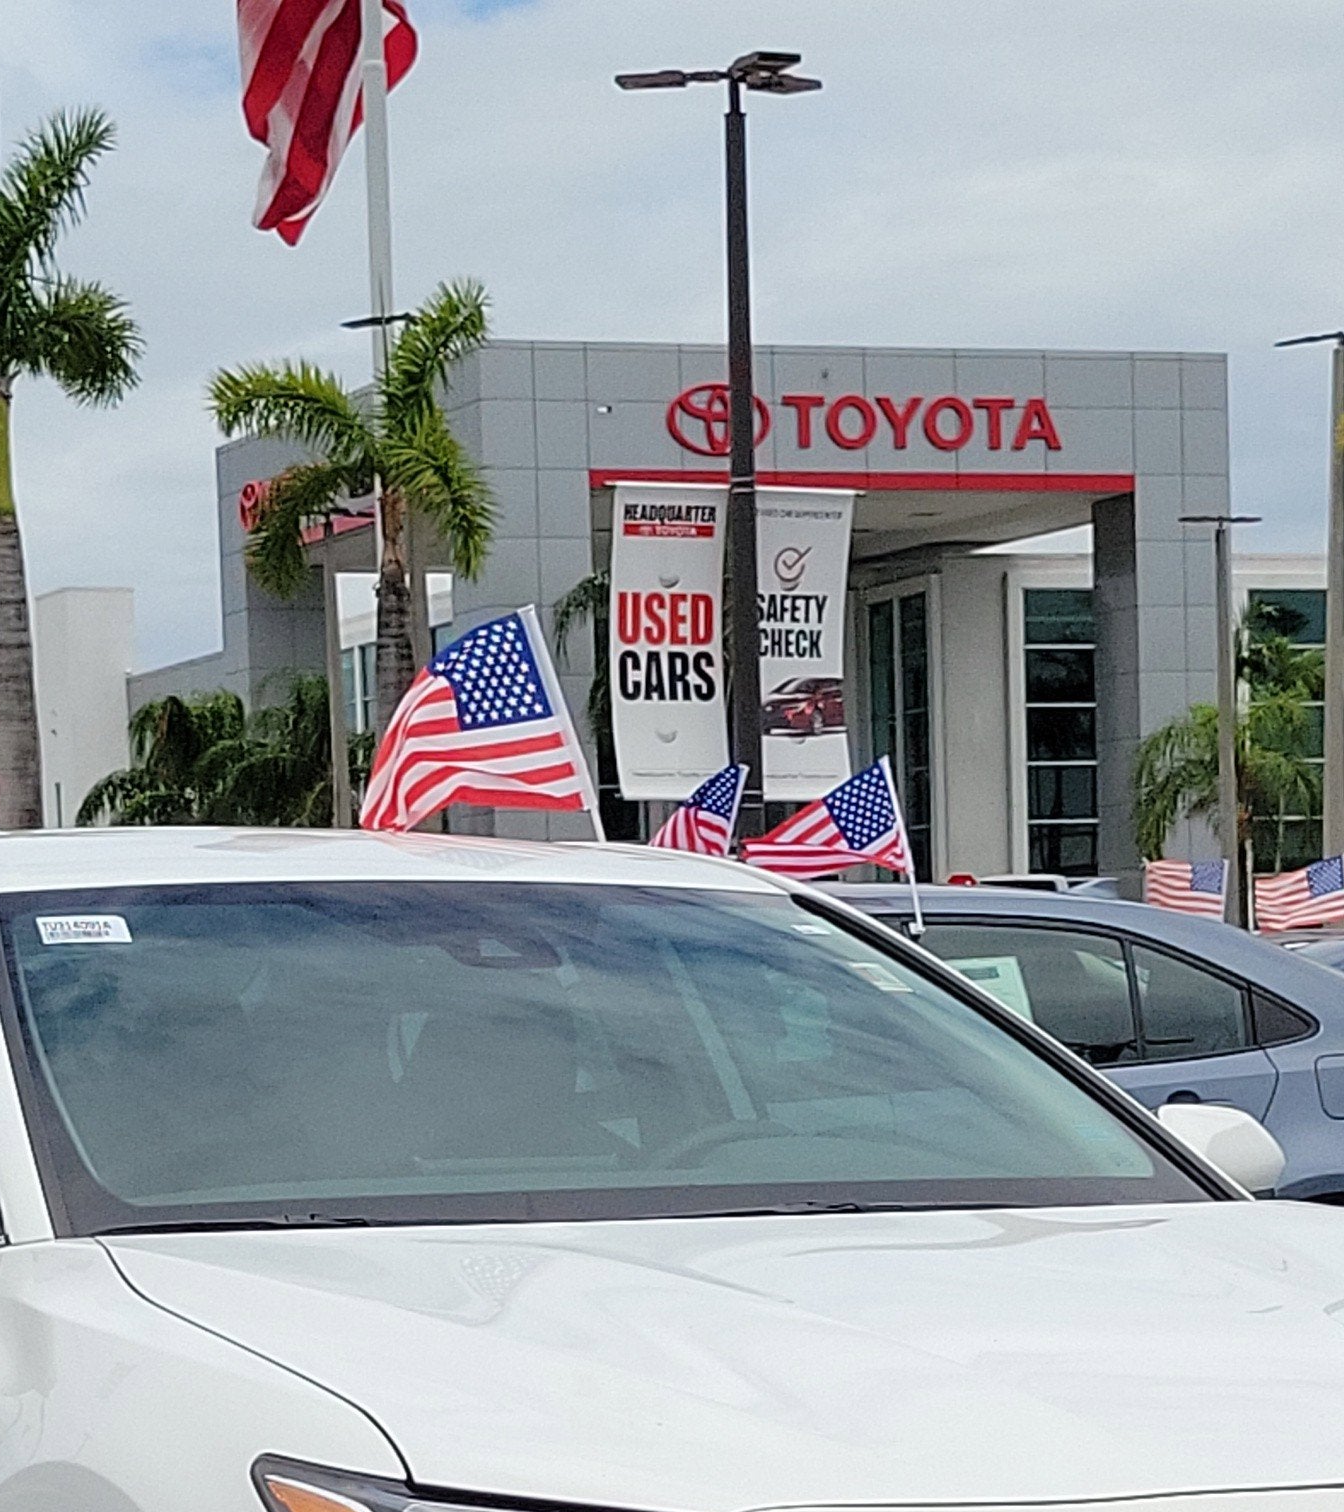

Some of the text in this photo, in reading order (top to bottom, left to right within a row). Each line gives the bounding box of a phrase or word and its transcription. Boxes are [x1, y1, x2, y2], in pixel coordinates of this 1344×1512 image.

[782, 395, 1062, 450] TOYOTA
[624, 503, 716, 525] HEADQUARTER
[618, 592, 714, 646] USED
[757, 594, 828, 624] SAFETY
[758, 628, 822, 658] CHECK
[619, 650, 716, 702] CARS
